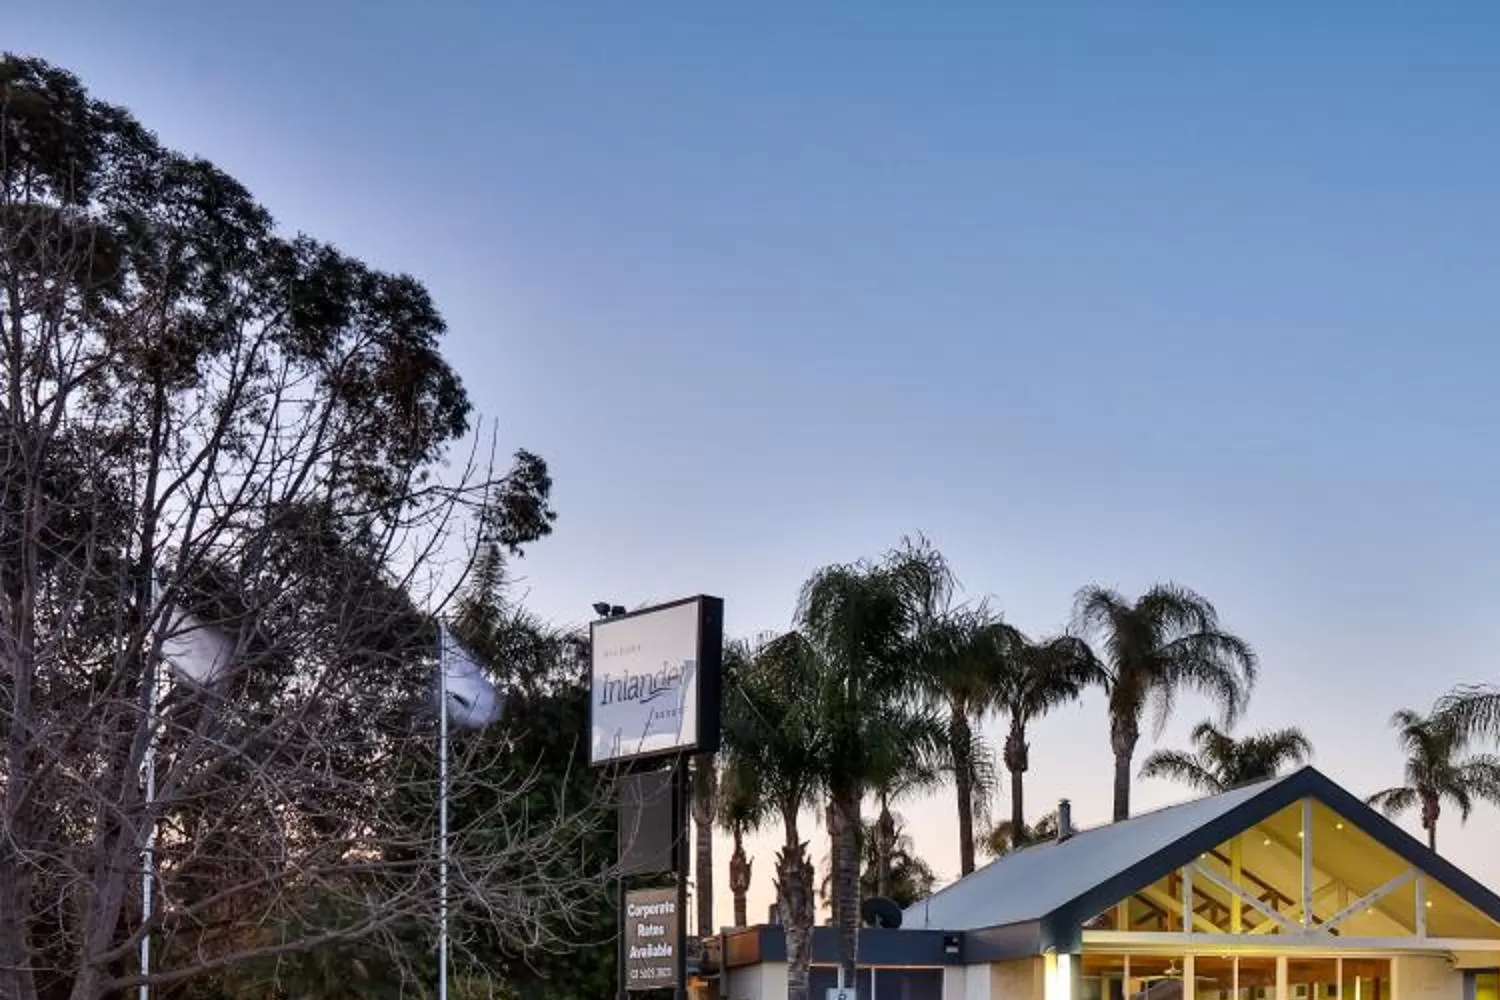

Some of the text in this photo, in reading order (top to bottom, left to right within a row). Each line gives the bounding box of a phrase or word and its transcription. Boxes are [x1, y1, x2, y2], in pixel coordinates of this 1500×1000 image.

[628, 901, 676, 919] Corporate
[637, 923, 665, 937] Rates
[629, 942, 673, 959] Available
